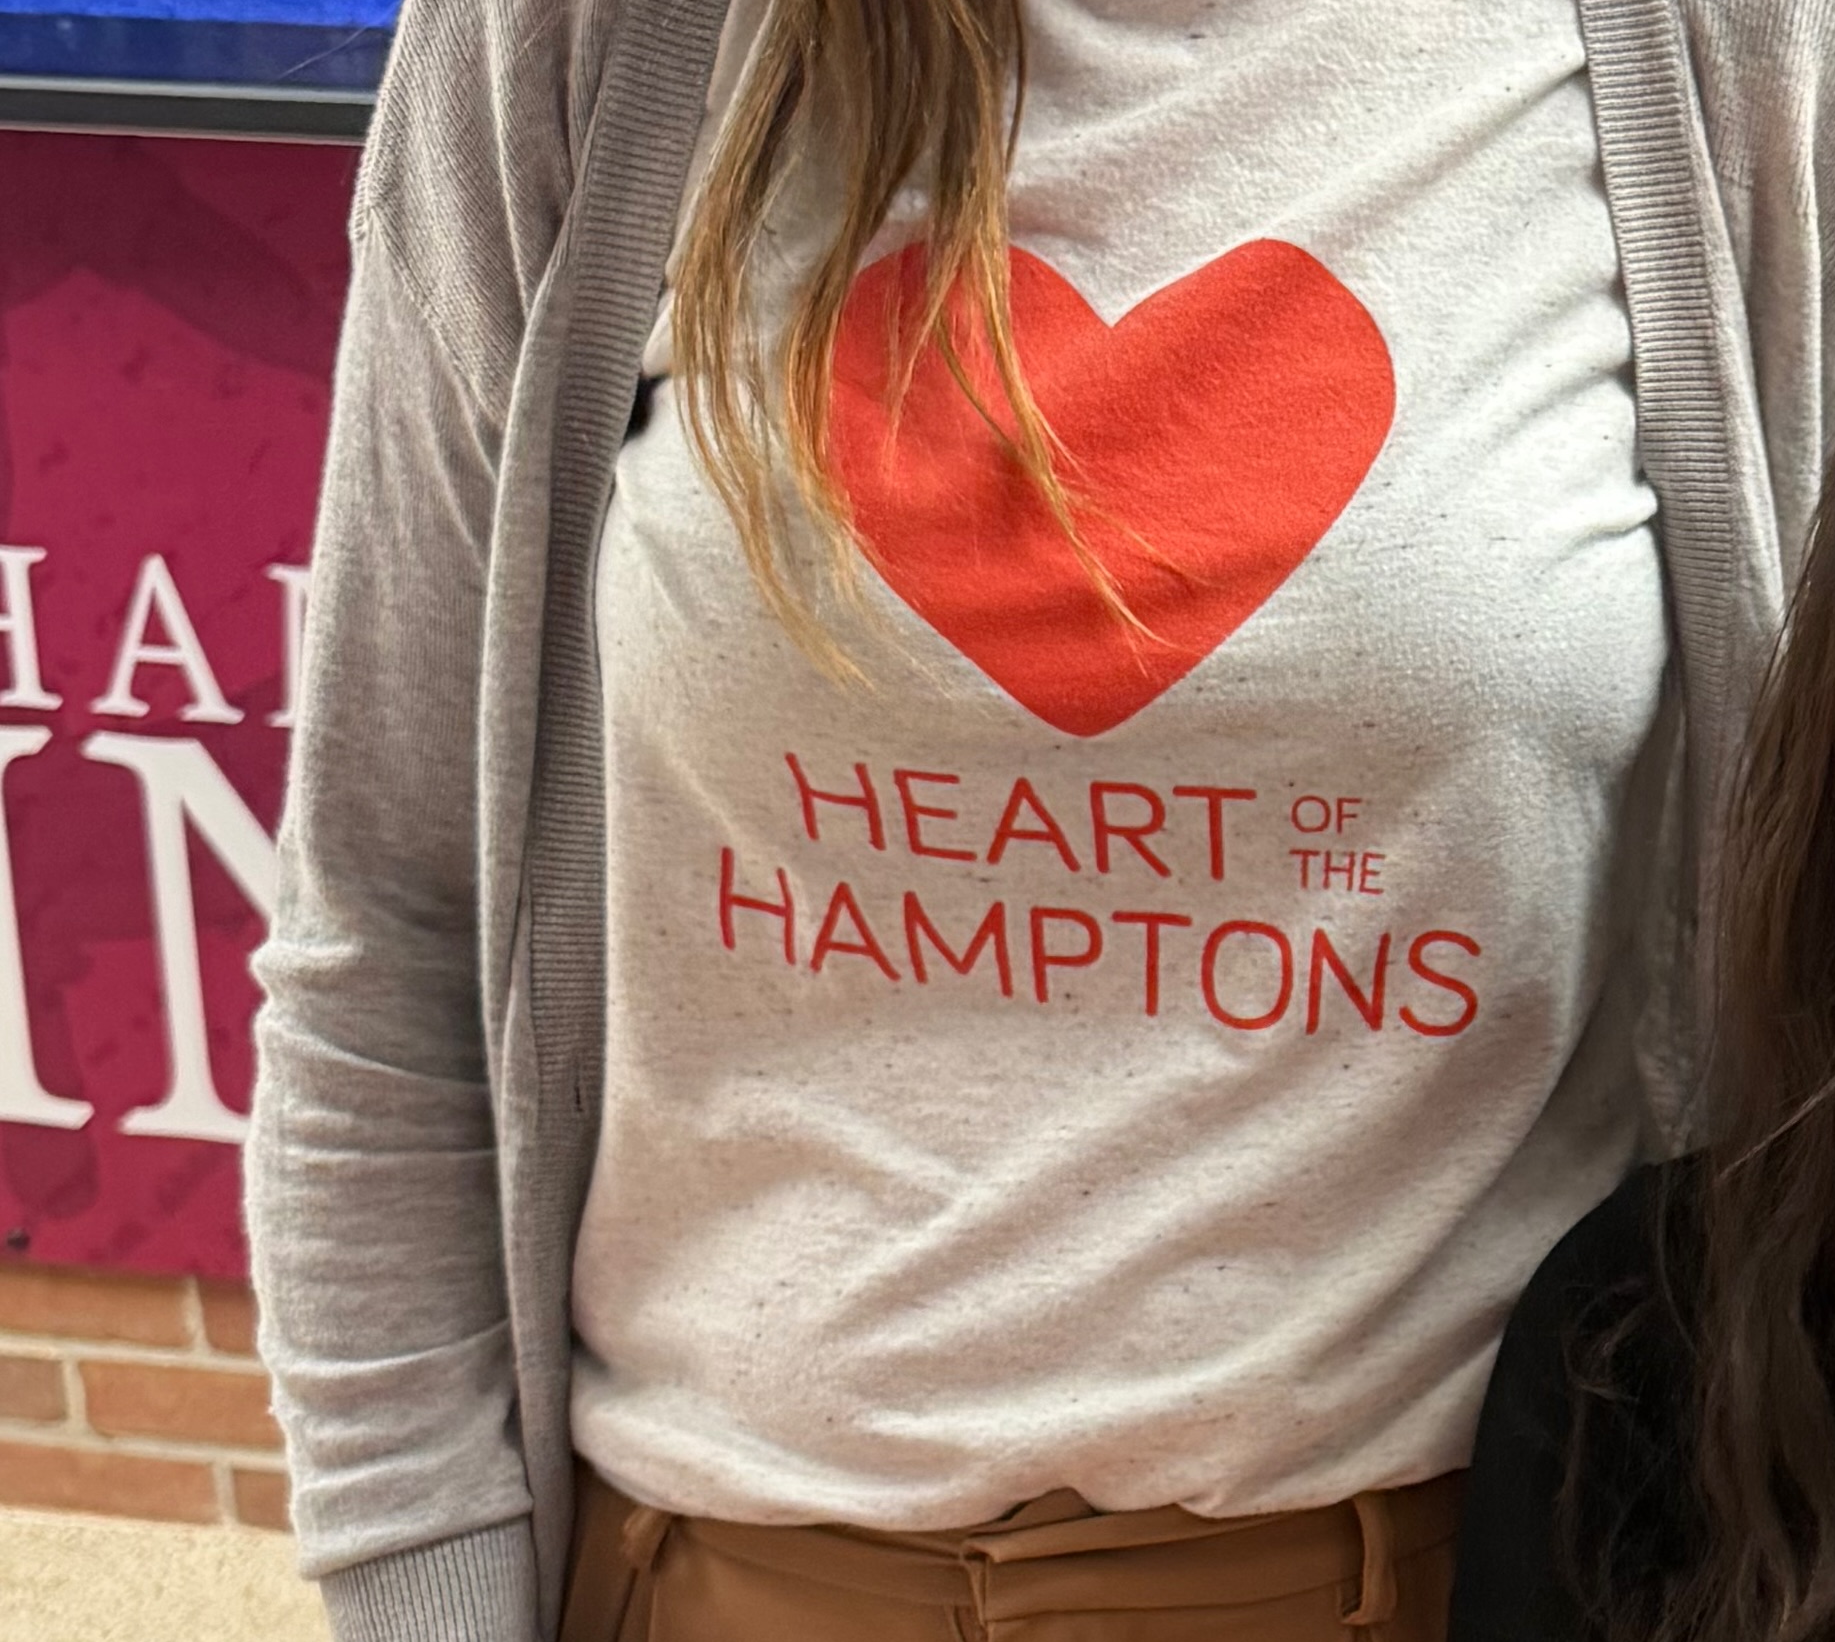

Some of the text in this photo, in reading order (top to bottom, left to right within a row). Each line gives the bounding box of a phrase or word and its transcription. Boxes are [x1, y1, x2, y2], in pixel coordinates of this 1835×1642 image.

[785, 752, 1363, 882] HEART OF
[1288, 849, 1387, 894] THE
[718, 846, 1483, 1038] HAMPTONS
